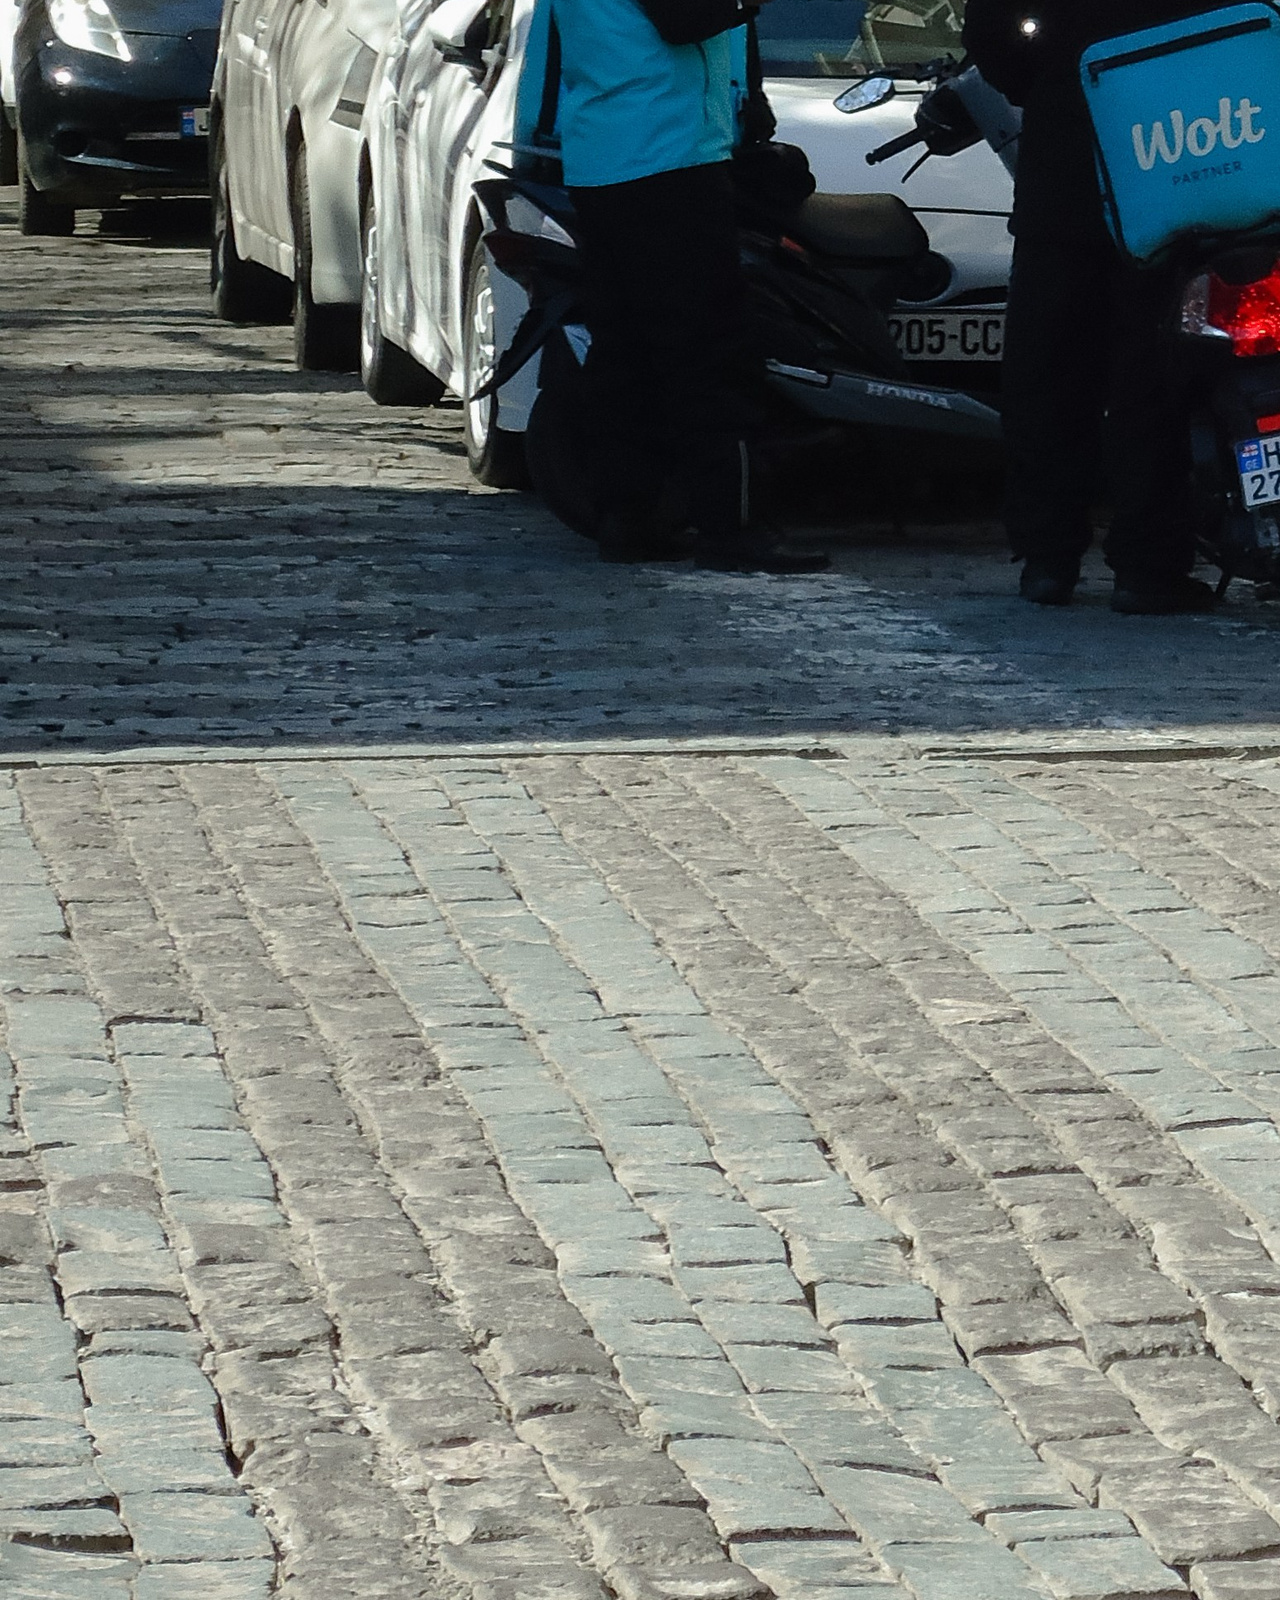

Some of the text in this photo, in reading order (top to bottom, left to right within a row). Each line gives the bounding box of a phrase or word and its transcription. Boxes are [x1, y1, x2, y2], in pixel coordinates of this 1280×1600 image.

[1131, 97, 1266, 171] Wolt
[1171, 160, 1242, 186] PARTNER
[865, 382, 951, 410] HONDA
[1244, 458, 1260, 471] GE
